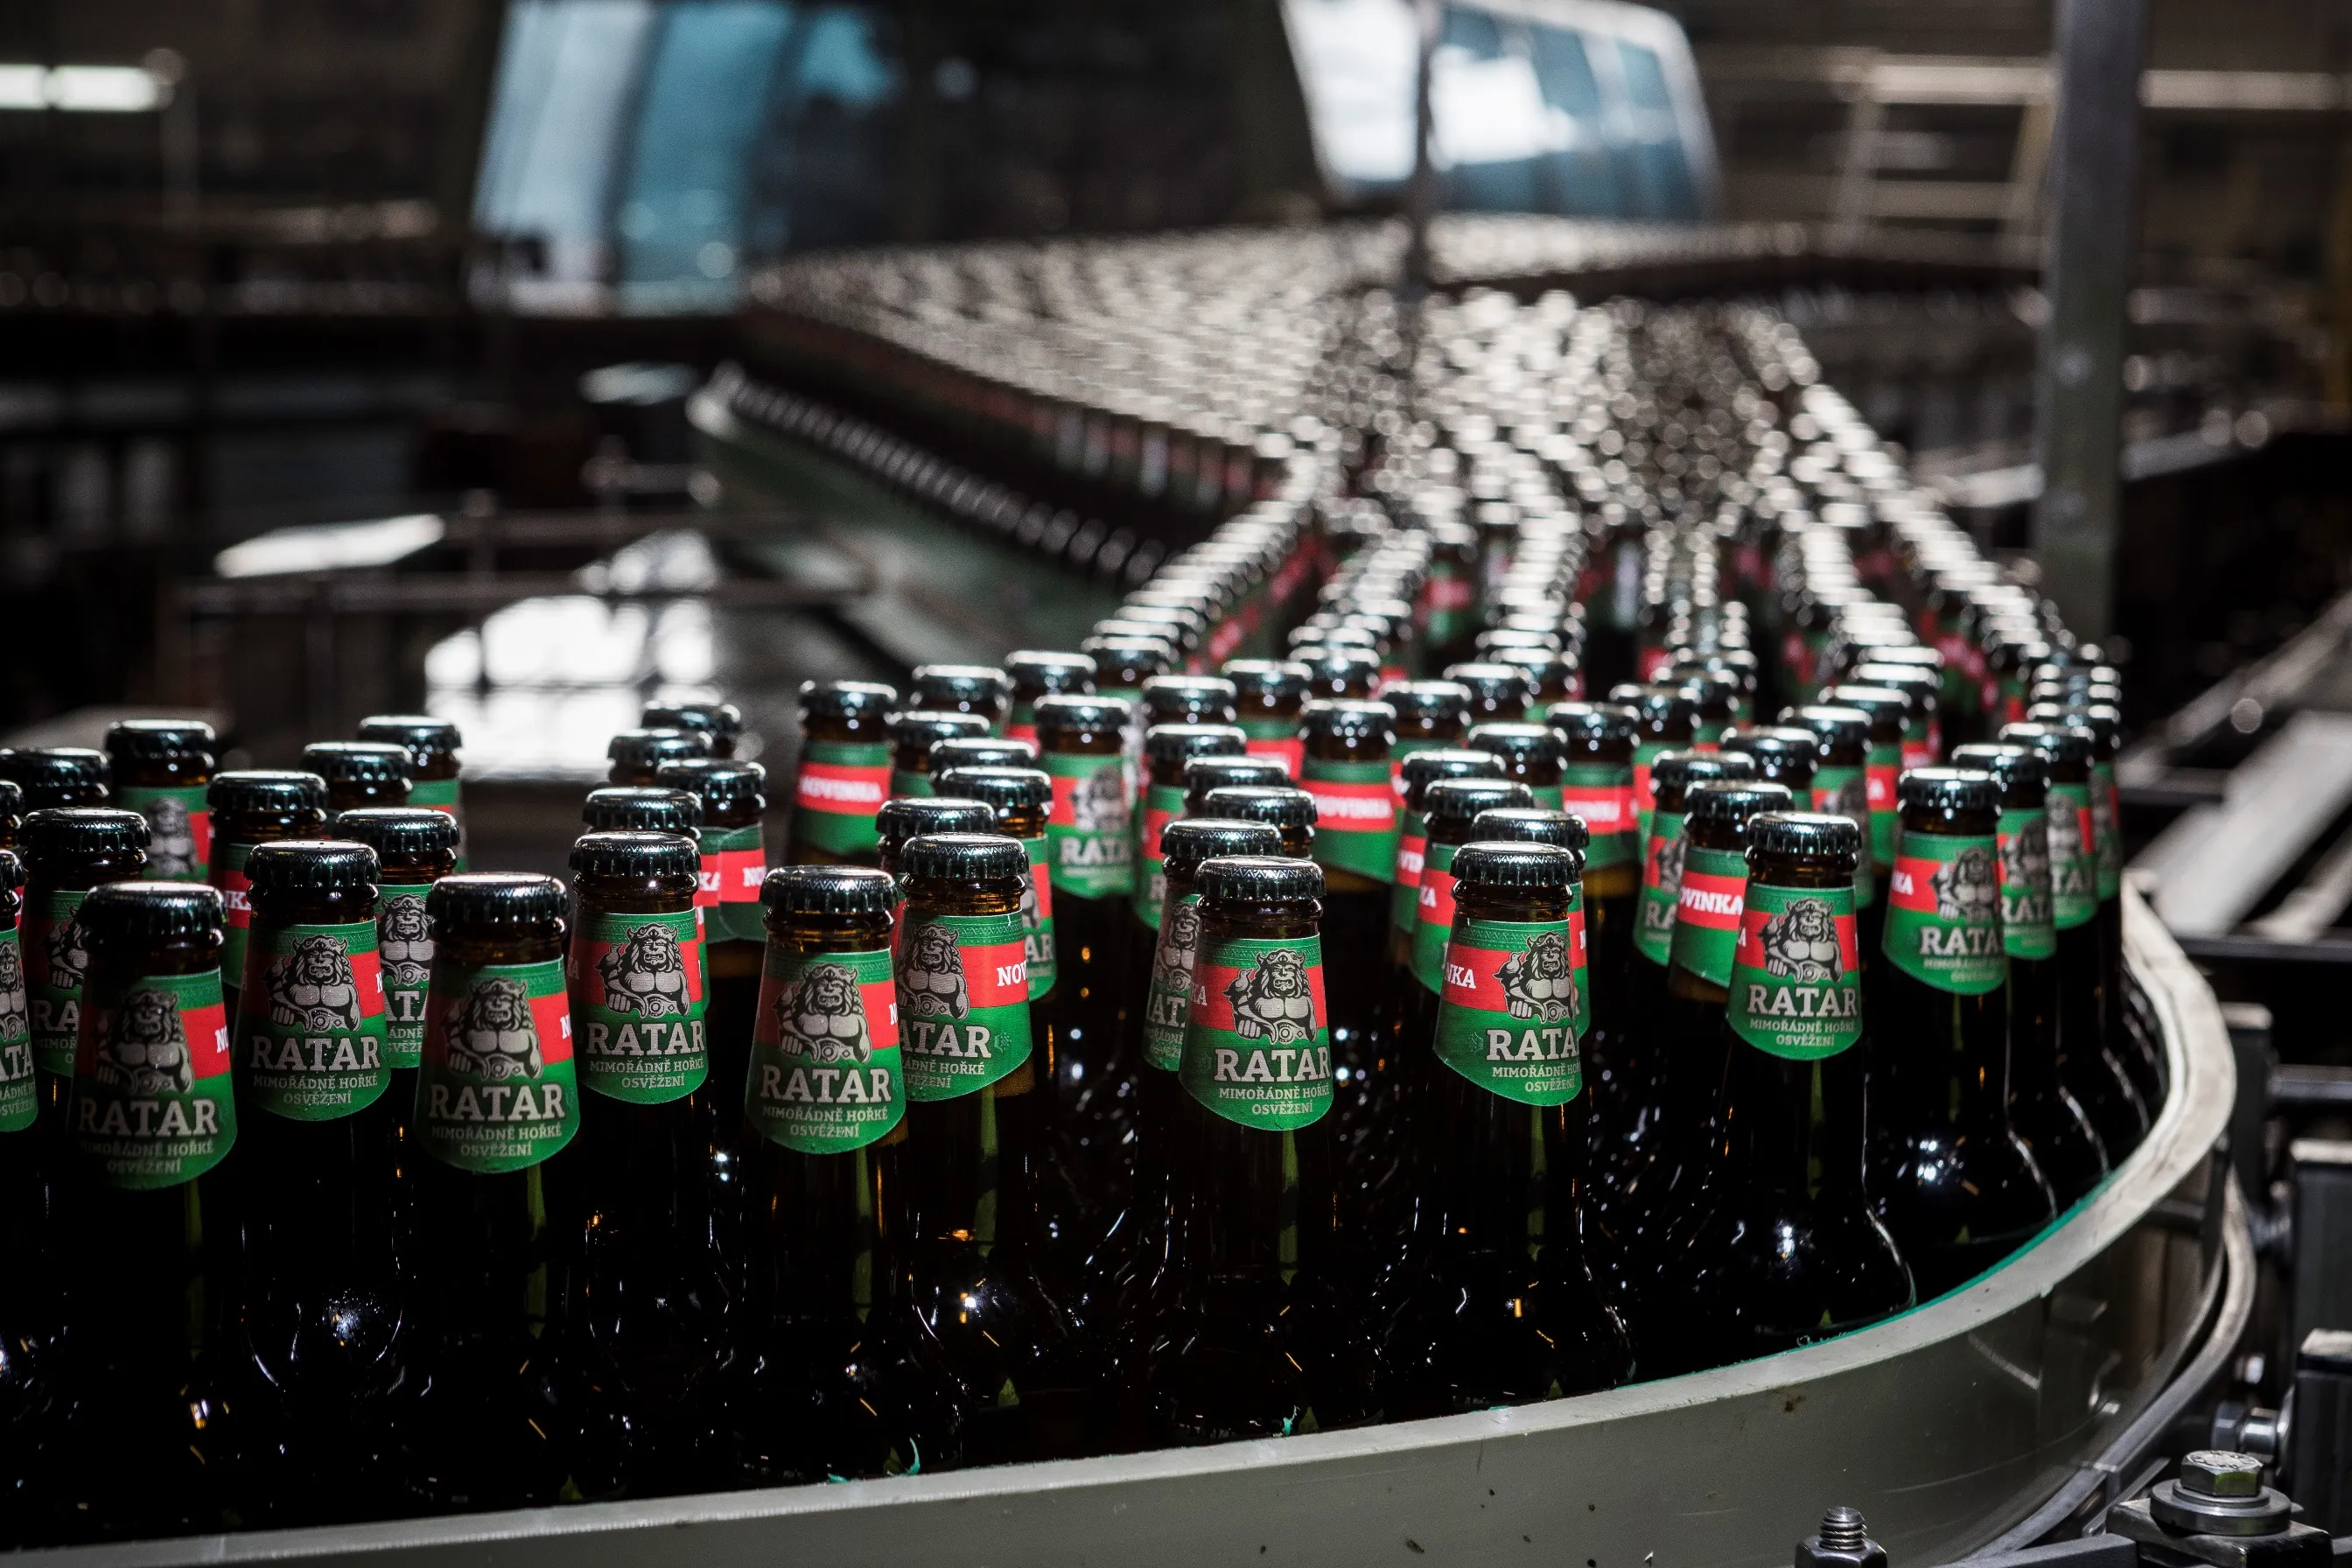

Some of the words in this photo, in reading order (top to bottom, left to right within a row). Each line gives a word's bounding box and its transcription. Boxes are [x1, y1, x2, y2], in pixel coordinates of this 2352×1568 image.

[1919, 926, 1999, 956] RATA
[1746, 984, 1857, 1017] RATAR
[1750, 1018, 1822, 1032] MIMOŘÁDNĚ
[585, 1020, 704, 1055] RATAR
[900, 1019, 991, 1058] ATAR
[1486, 1026, 1580, 1061] RATA
[250, 1035, 381, 1071] RATAR
[589, 1059, 671, 1074] MIMOŘÁDNĚ
[674, 1056, 704, 1071] HOŘKÉ
[939, 1060, 984, 1074] HOŘKÉ
[1214, 1046, 1330, 1082] RATAR
[1492, 1062, 1565, 1077] MIMOŘÁDNĚ
[252, 1074, 336, 1089] MIMOŘÁDNĚ
[339, 1073, 378, 1088] HOŘKÉ
[621, 1073, 684, 1088] OSVĚŽENÍ
[760, 1064, 892, 1103] RATAR
[284, 1090, 352, 1104] OSVĚŽENÍ
[1219, 1086, 1300, 1100] MIMOŘÁDNĚ
[428, 1083, 566, 1121] RATAR
[1251, 1100, 1312, 1116] OSVĚŽENÍ
[78, 1096, 218, 1137] RATAR
[762, 1106, 843, 1123] MIMOŘÁDNĚ
[846, 1106, 888, 1122] HOŘKÉ
[431, 1124, 514, 1140] MIMOŘÁDNĚ
[518, 1123, 562, 1139] HOŘKÉ
[789, 1124, 859, 1138] OSVĚŽENÍ
[166, 1138, 214, 1156] HOŘKÉ
[460, 1141, 532, 1157] OSVĚŽENÍ
